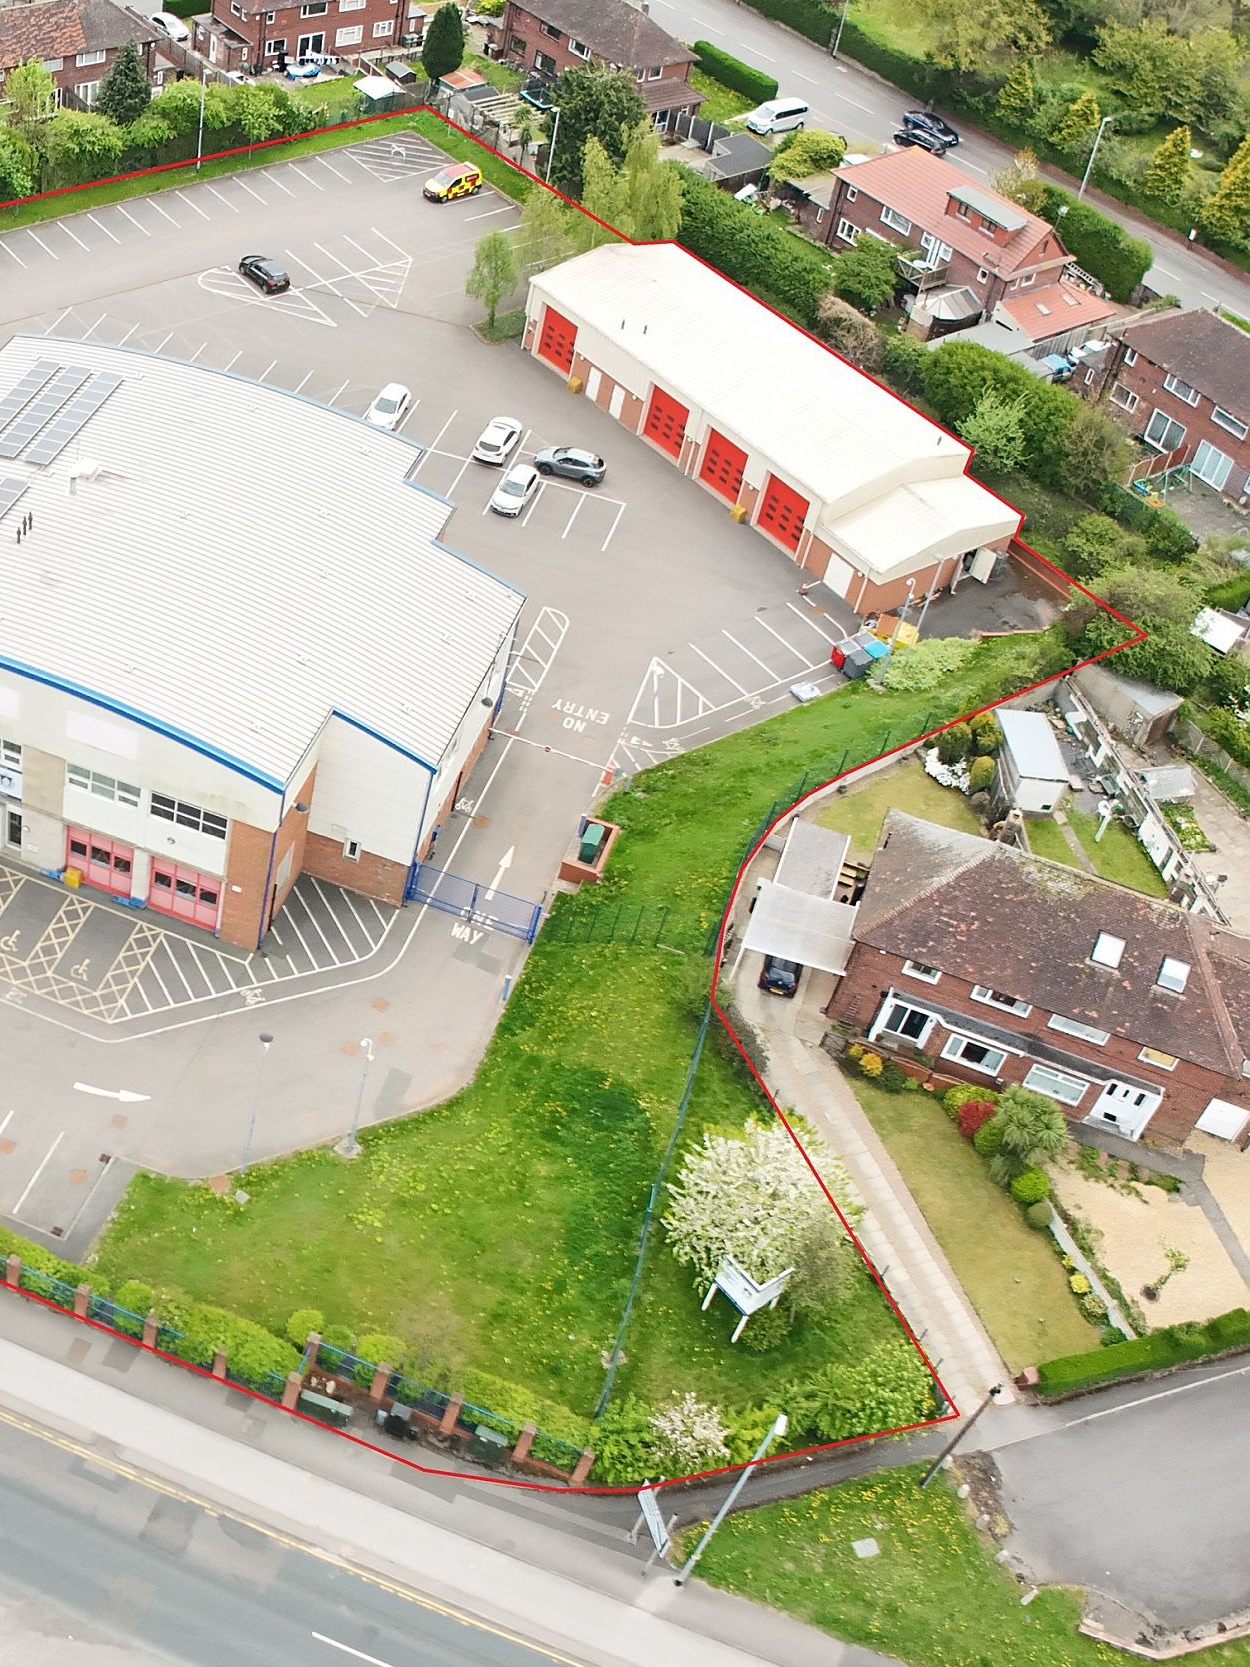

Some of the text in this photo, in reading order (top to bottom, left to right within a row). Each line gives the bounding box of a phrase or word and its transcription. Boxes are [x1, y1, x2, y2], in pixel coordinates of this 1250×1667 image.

[551, 698, 610, 725] ENTRY
[562, 716, 587, 733] NO
[451, 922, 484, 945] WAY
